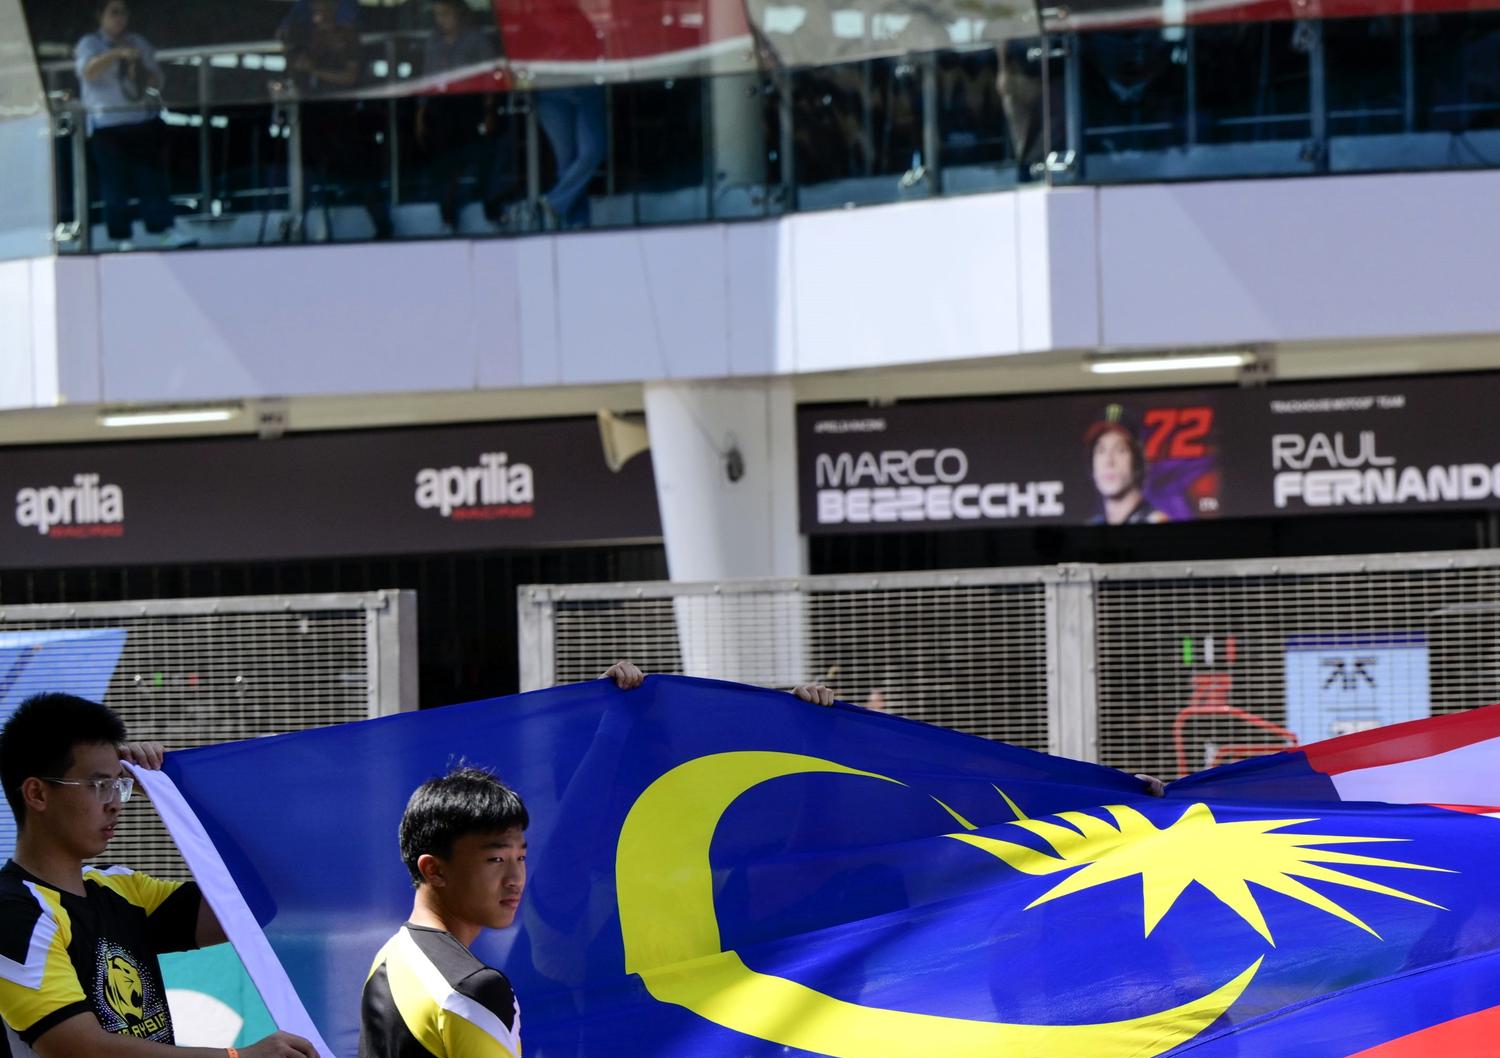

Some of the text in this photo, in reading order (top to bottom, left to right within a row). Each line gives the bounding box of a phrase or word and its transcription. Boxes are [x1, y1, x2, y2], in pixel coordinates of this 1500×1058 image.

[1143, 406, 1213, 460] 72
[1271, 430, 1397, 470] RAUL
[415, 451, 534, 517] aprilia
[816, 448, 968, 487] MARCO
[15, 472, 124, 535] aprilia
[817, 480, 1065, 524] BEZZECCHI
